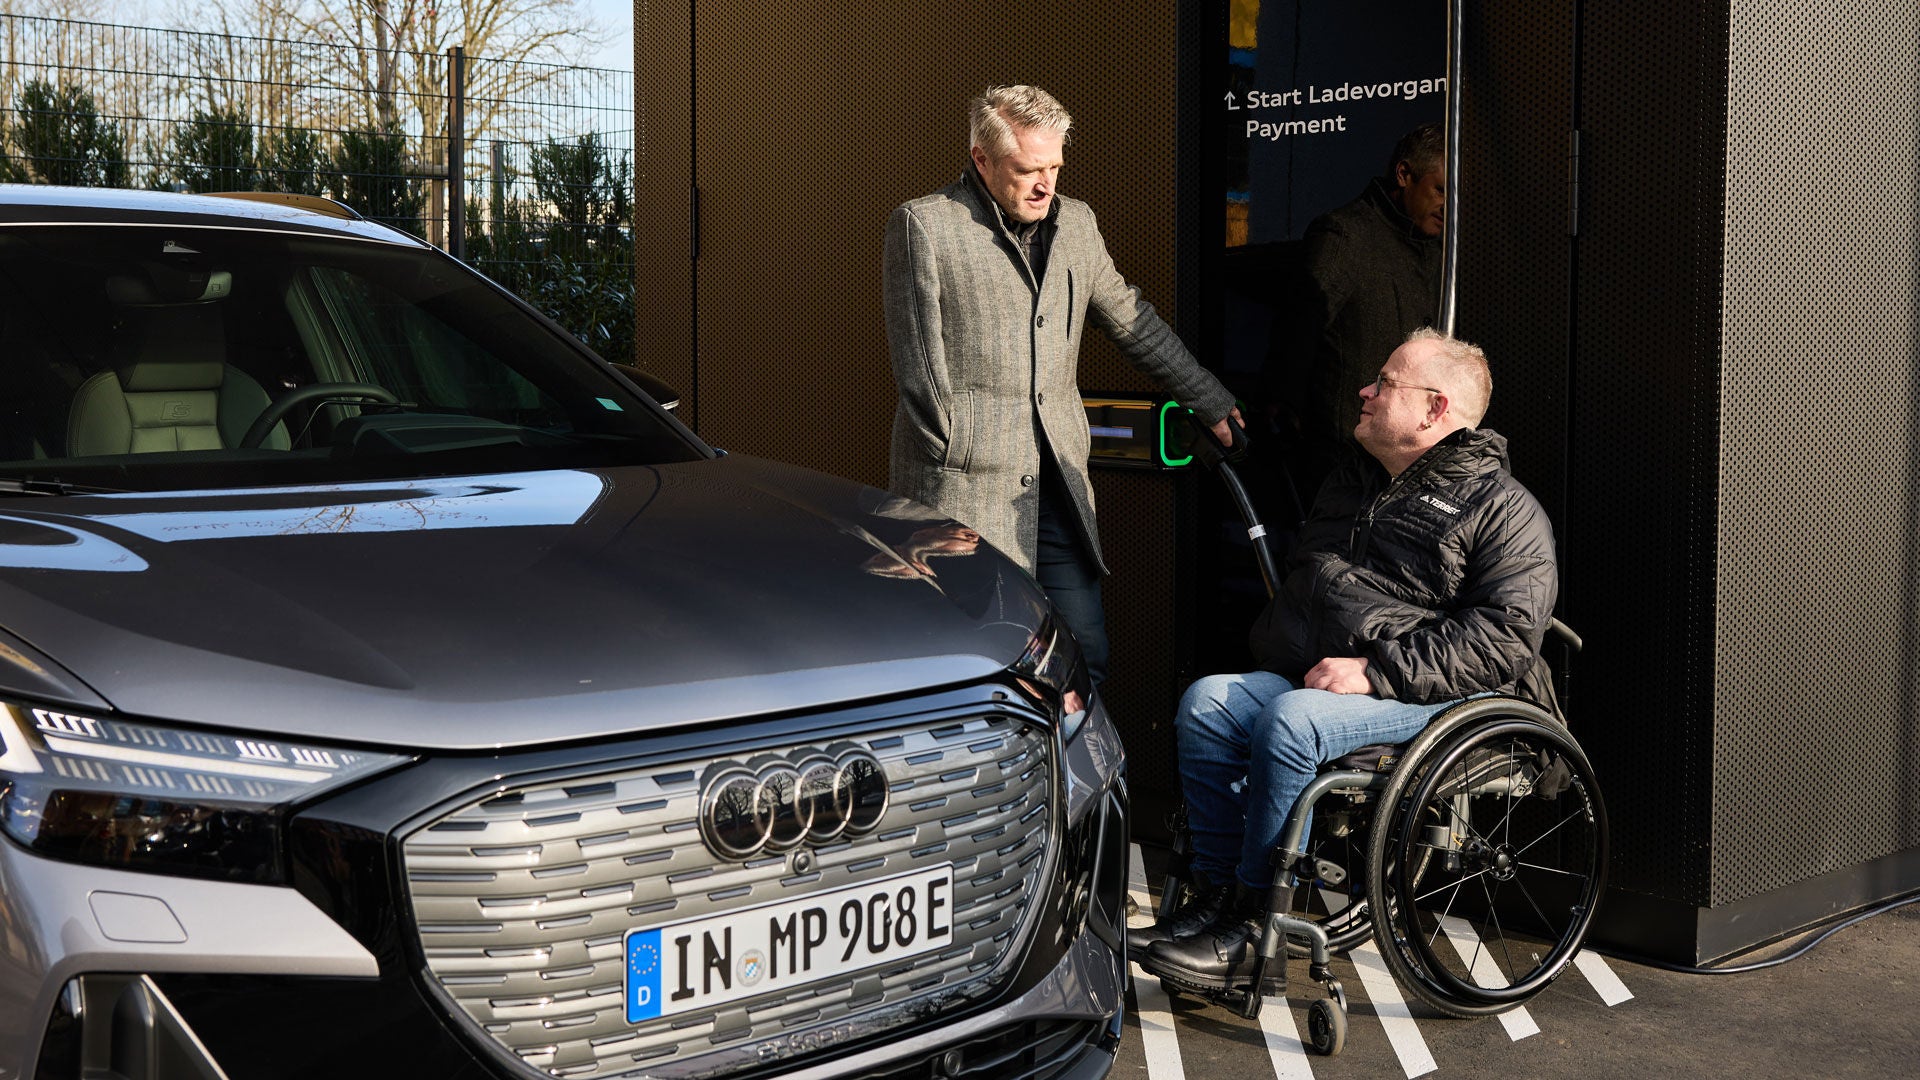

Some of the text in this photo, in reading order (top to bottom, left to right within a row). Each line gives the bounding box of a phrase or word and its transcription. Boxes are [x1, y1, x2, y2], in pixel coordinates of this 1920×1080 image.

[1247, 77, 1447, 109] Start Ladevorgan
[1246, 114, 1346, 141] Payment
[671, 926, 732, 1003] IN
[769, 906, 828, 979] MP
[838, 886, 917, 963] 908
[637, 985, 651, 1007] D
